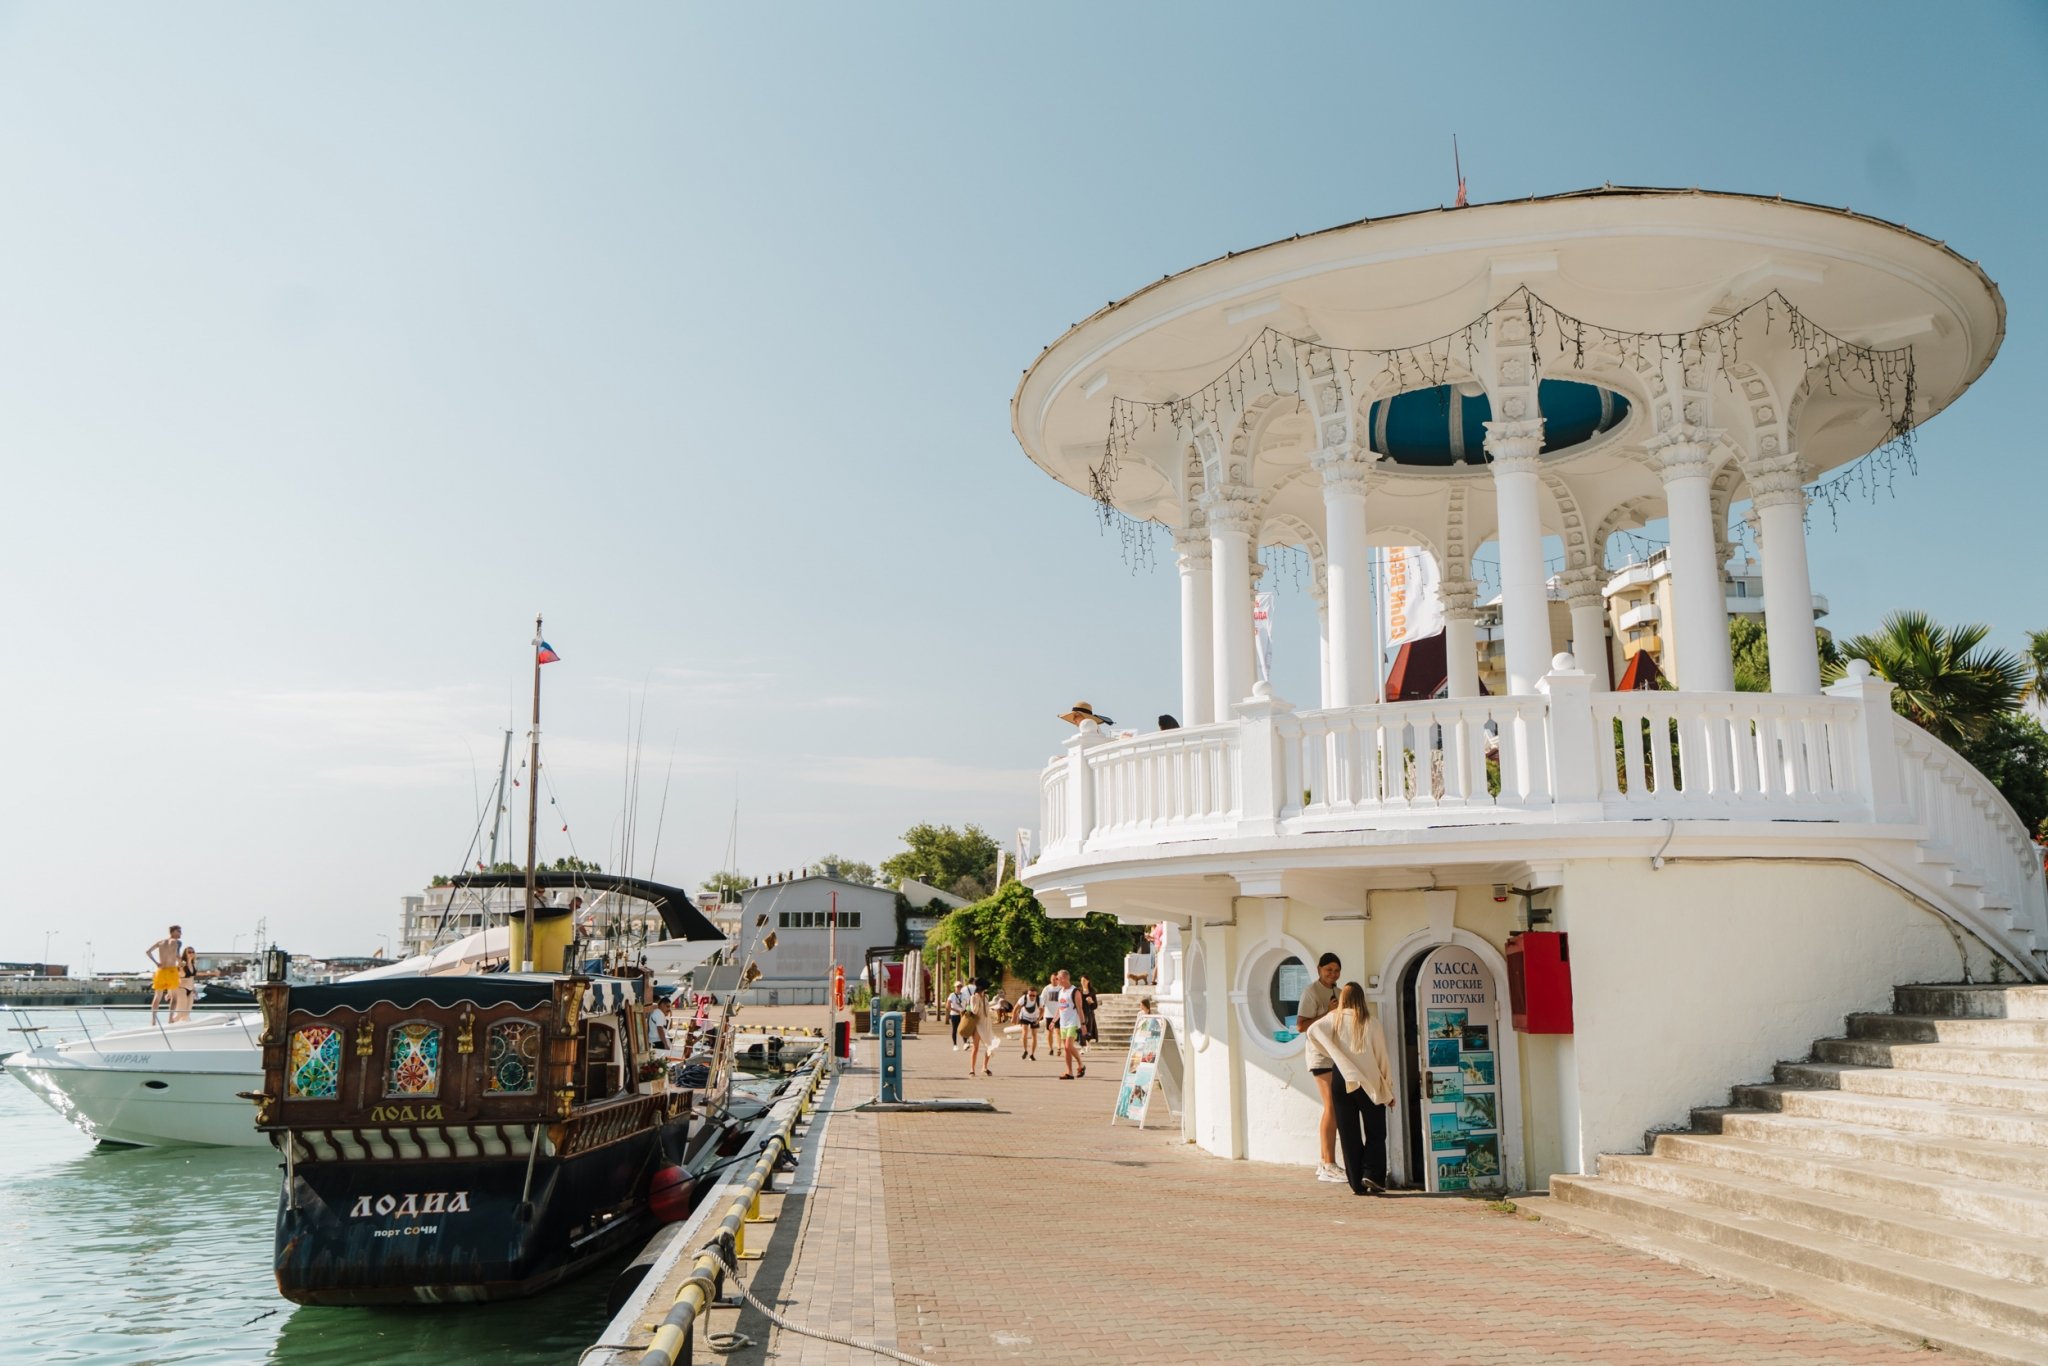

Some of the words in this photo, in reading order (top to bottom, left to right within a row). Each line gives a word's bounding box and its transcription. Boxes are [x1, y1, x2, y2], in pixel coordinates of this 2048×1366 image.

[1434, 962, 1479, 975] КАССА
[1432, 979, 1483, 989] МОРСКИЕ
[1431, 993, 1485, 1004] ПРОГУЛКИ
[103, 1054, 152, 1064] МИРАЖ
[374, 1229, 401, 1238] порт
[403, 1225, 438, 1235] СОЧИ
